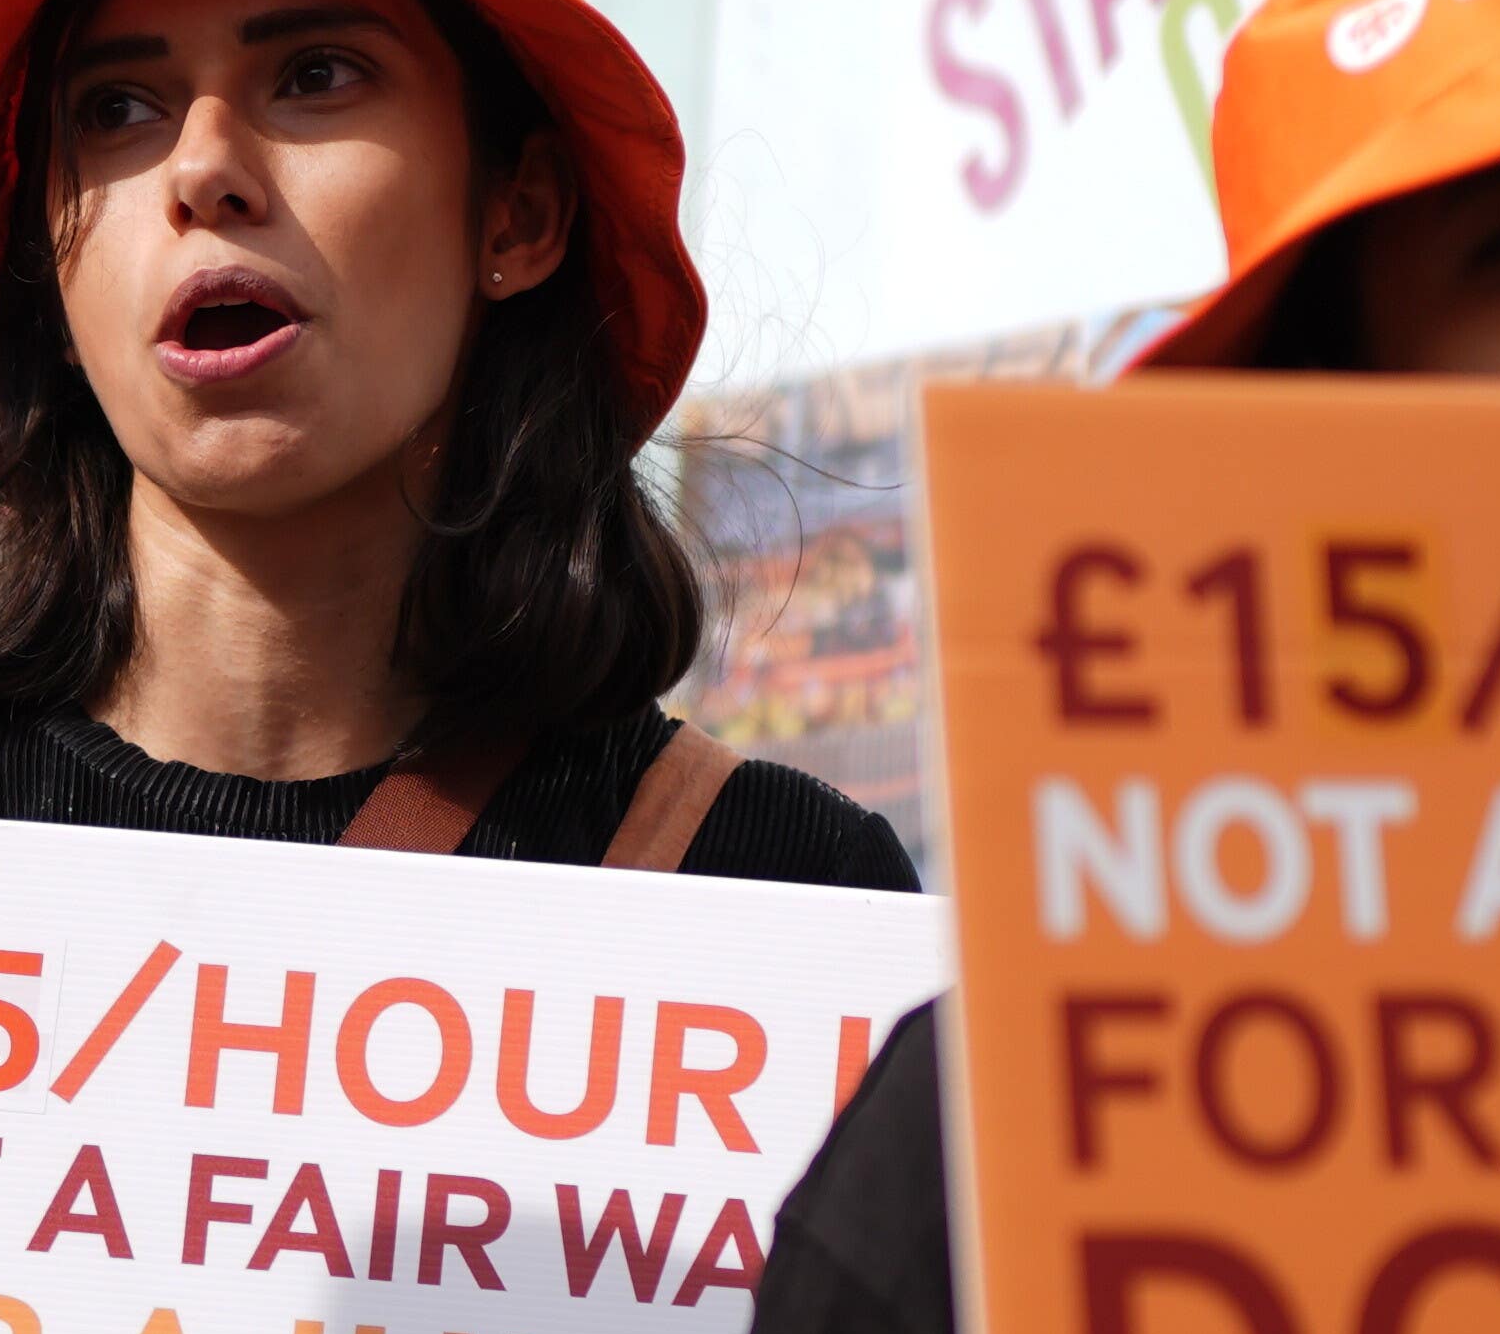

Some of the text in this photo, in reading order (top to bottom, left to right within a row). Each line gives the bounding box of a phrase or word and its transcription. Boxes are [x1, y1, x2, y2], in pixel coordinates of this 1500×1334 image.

[1034, 777, 1416, 943] NOT
[833, 1015, 872, 1124] I
[26, 1144, 134, 1260] A
[181, 1153, 508, 1292] FAIR
[555, 1183, 767, 1307] WA
